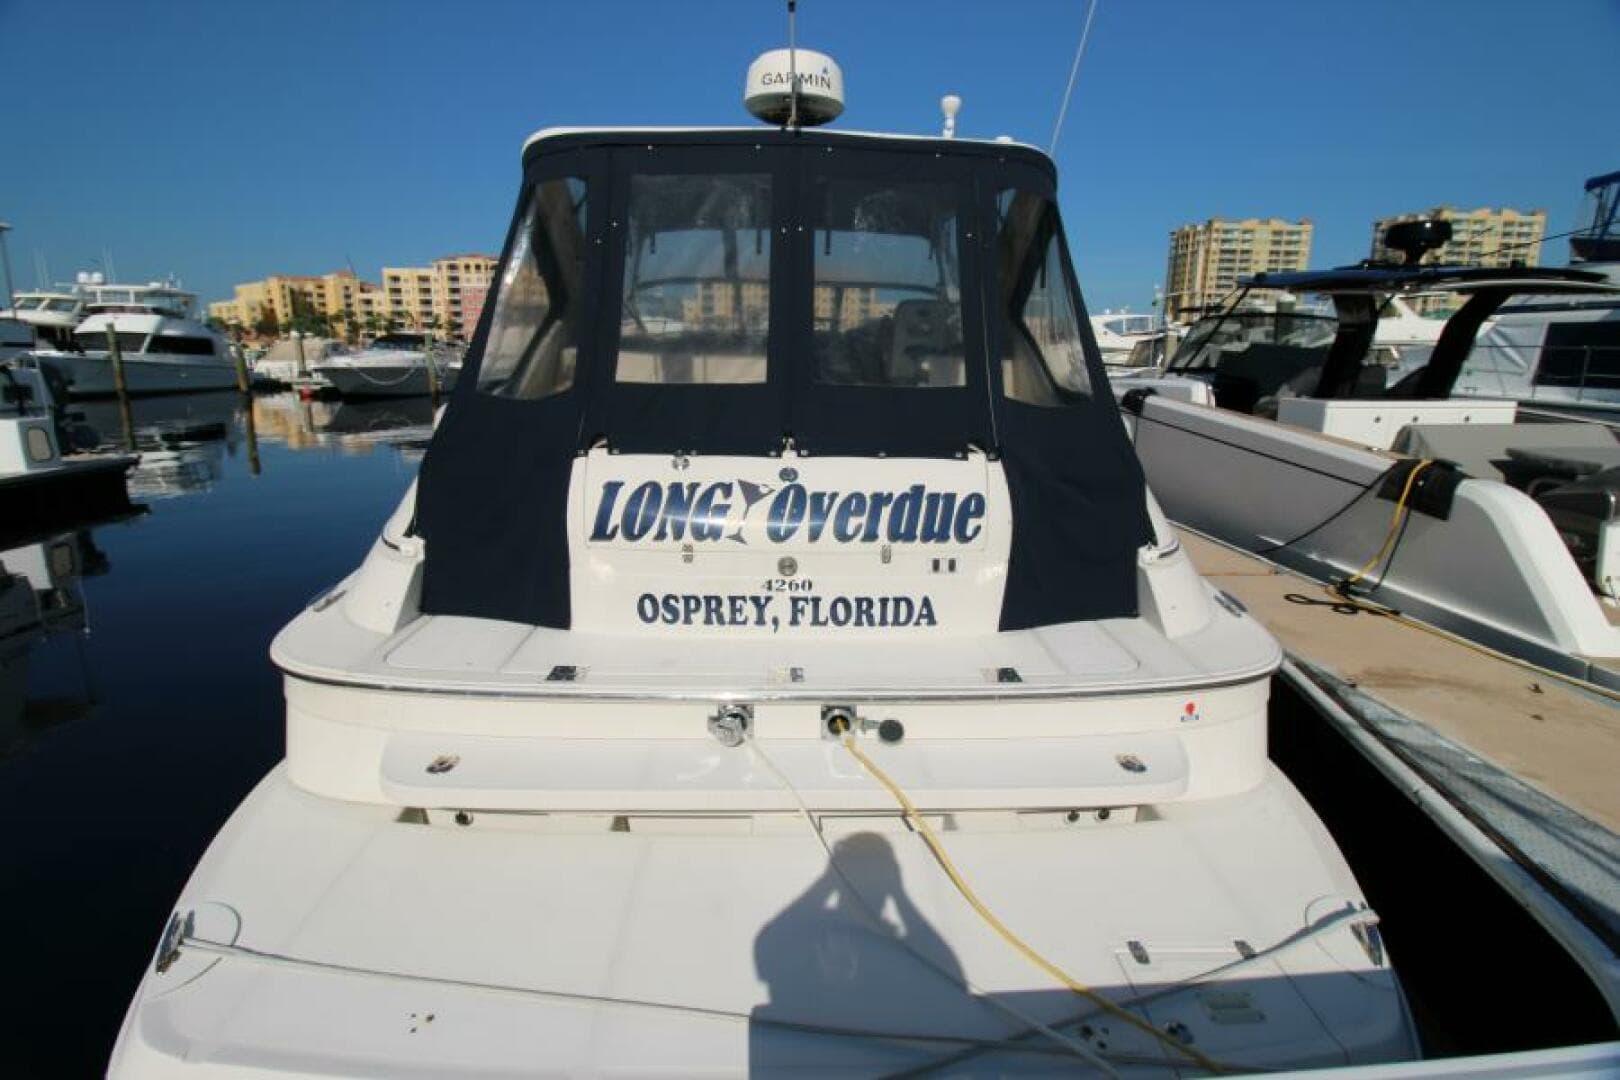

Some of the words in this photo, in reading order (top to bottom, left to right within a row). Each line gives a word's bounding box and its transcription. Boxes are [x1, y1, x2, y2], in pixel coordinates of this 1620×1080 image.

[589, 481, 734, 542] LONG
[767, 483, 986, 544] Overdue
[762, 579, 813, 592] 4260
[637, 593, 779, 633] OSPREY,
[789, 596, 937, 627] FLORIDA
